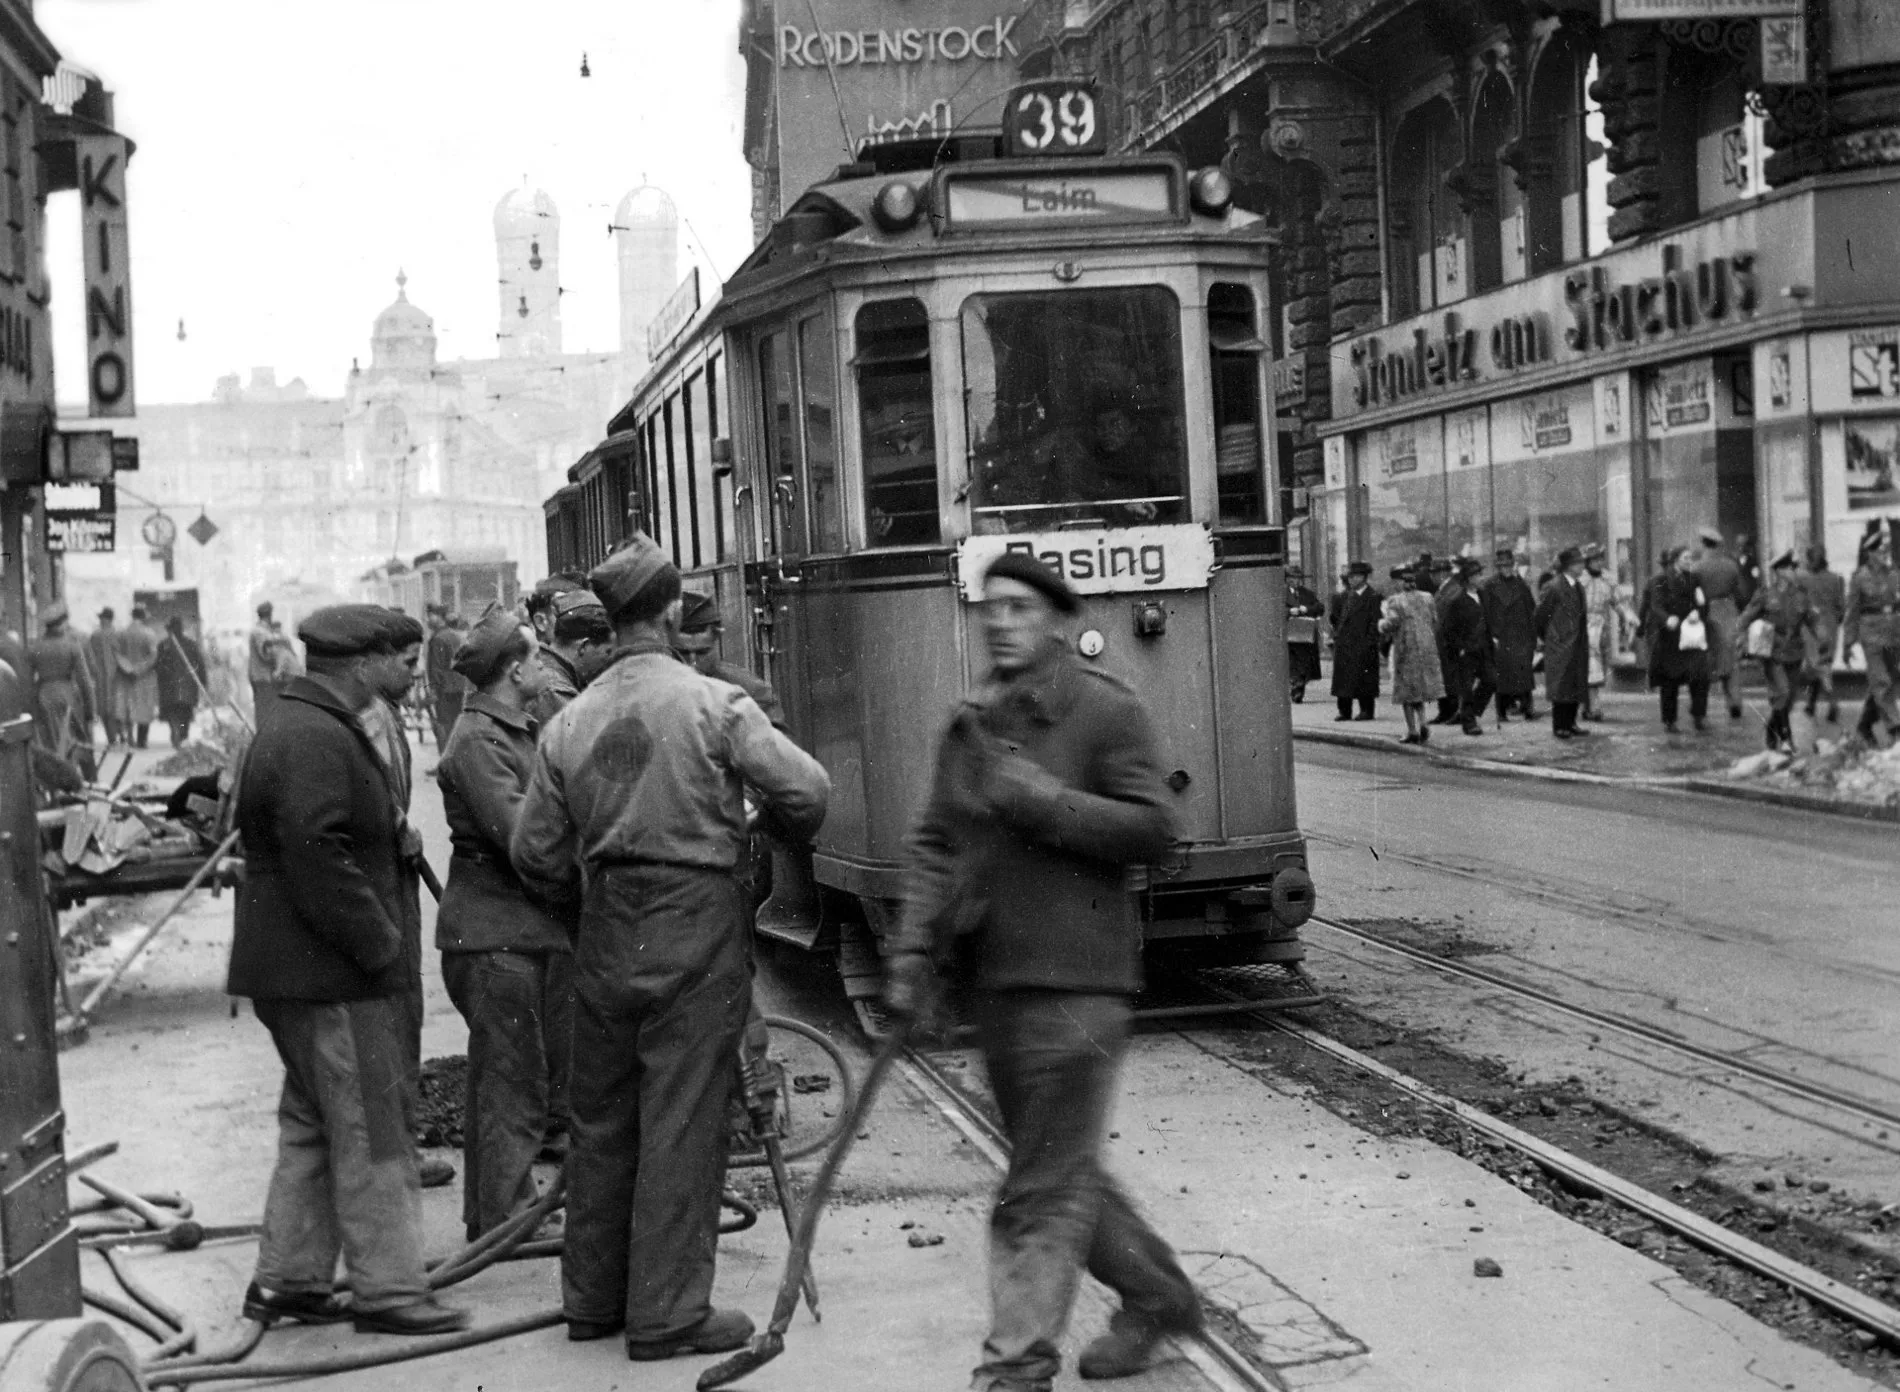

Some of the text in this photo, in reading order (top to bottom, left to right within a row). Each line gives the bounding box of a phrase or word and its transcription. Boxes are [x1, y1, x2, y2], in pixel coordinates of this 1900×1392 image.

[779, 15, 1018, 67] RODENSTOCK
[1018, 90, 1096, 149] 39
[1022, 181, 1096, 213] Laim
[84, 154, 127, 405] KINO
[1490, 311, 1550, 370] am
[1564, 244, 1757, 351] Stachus
